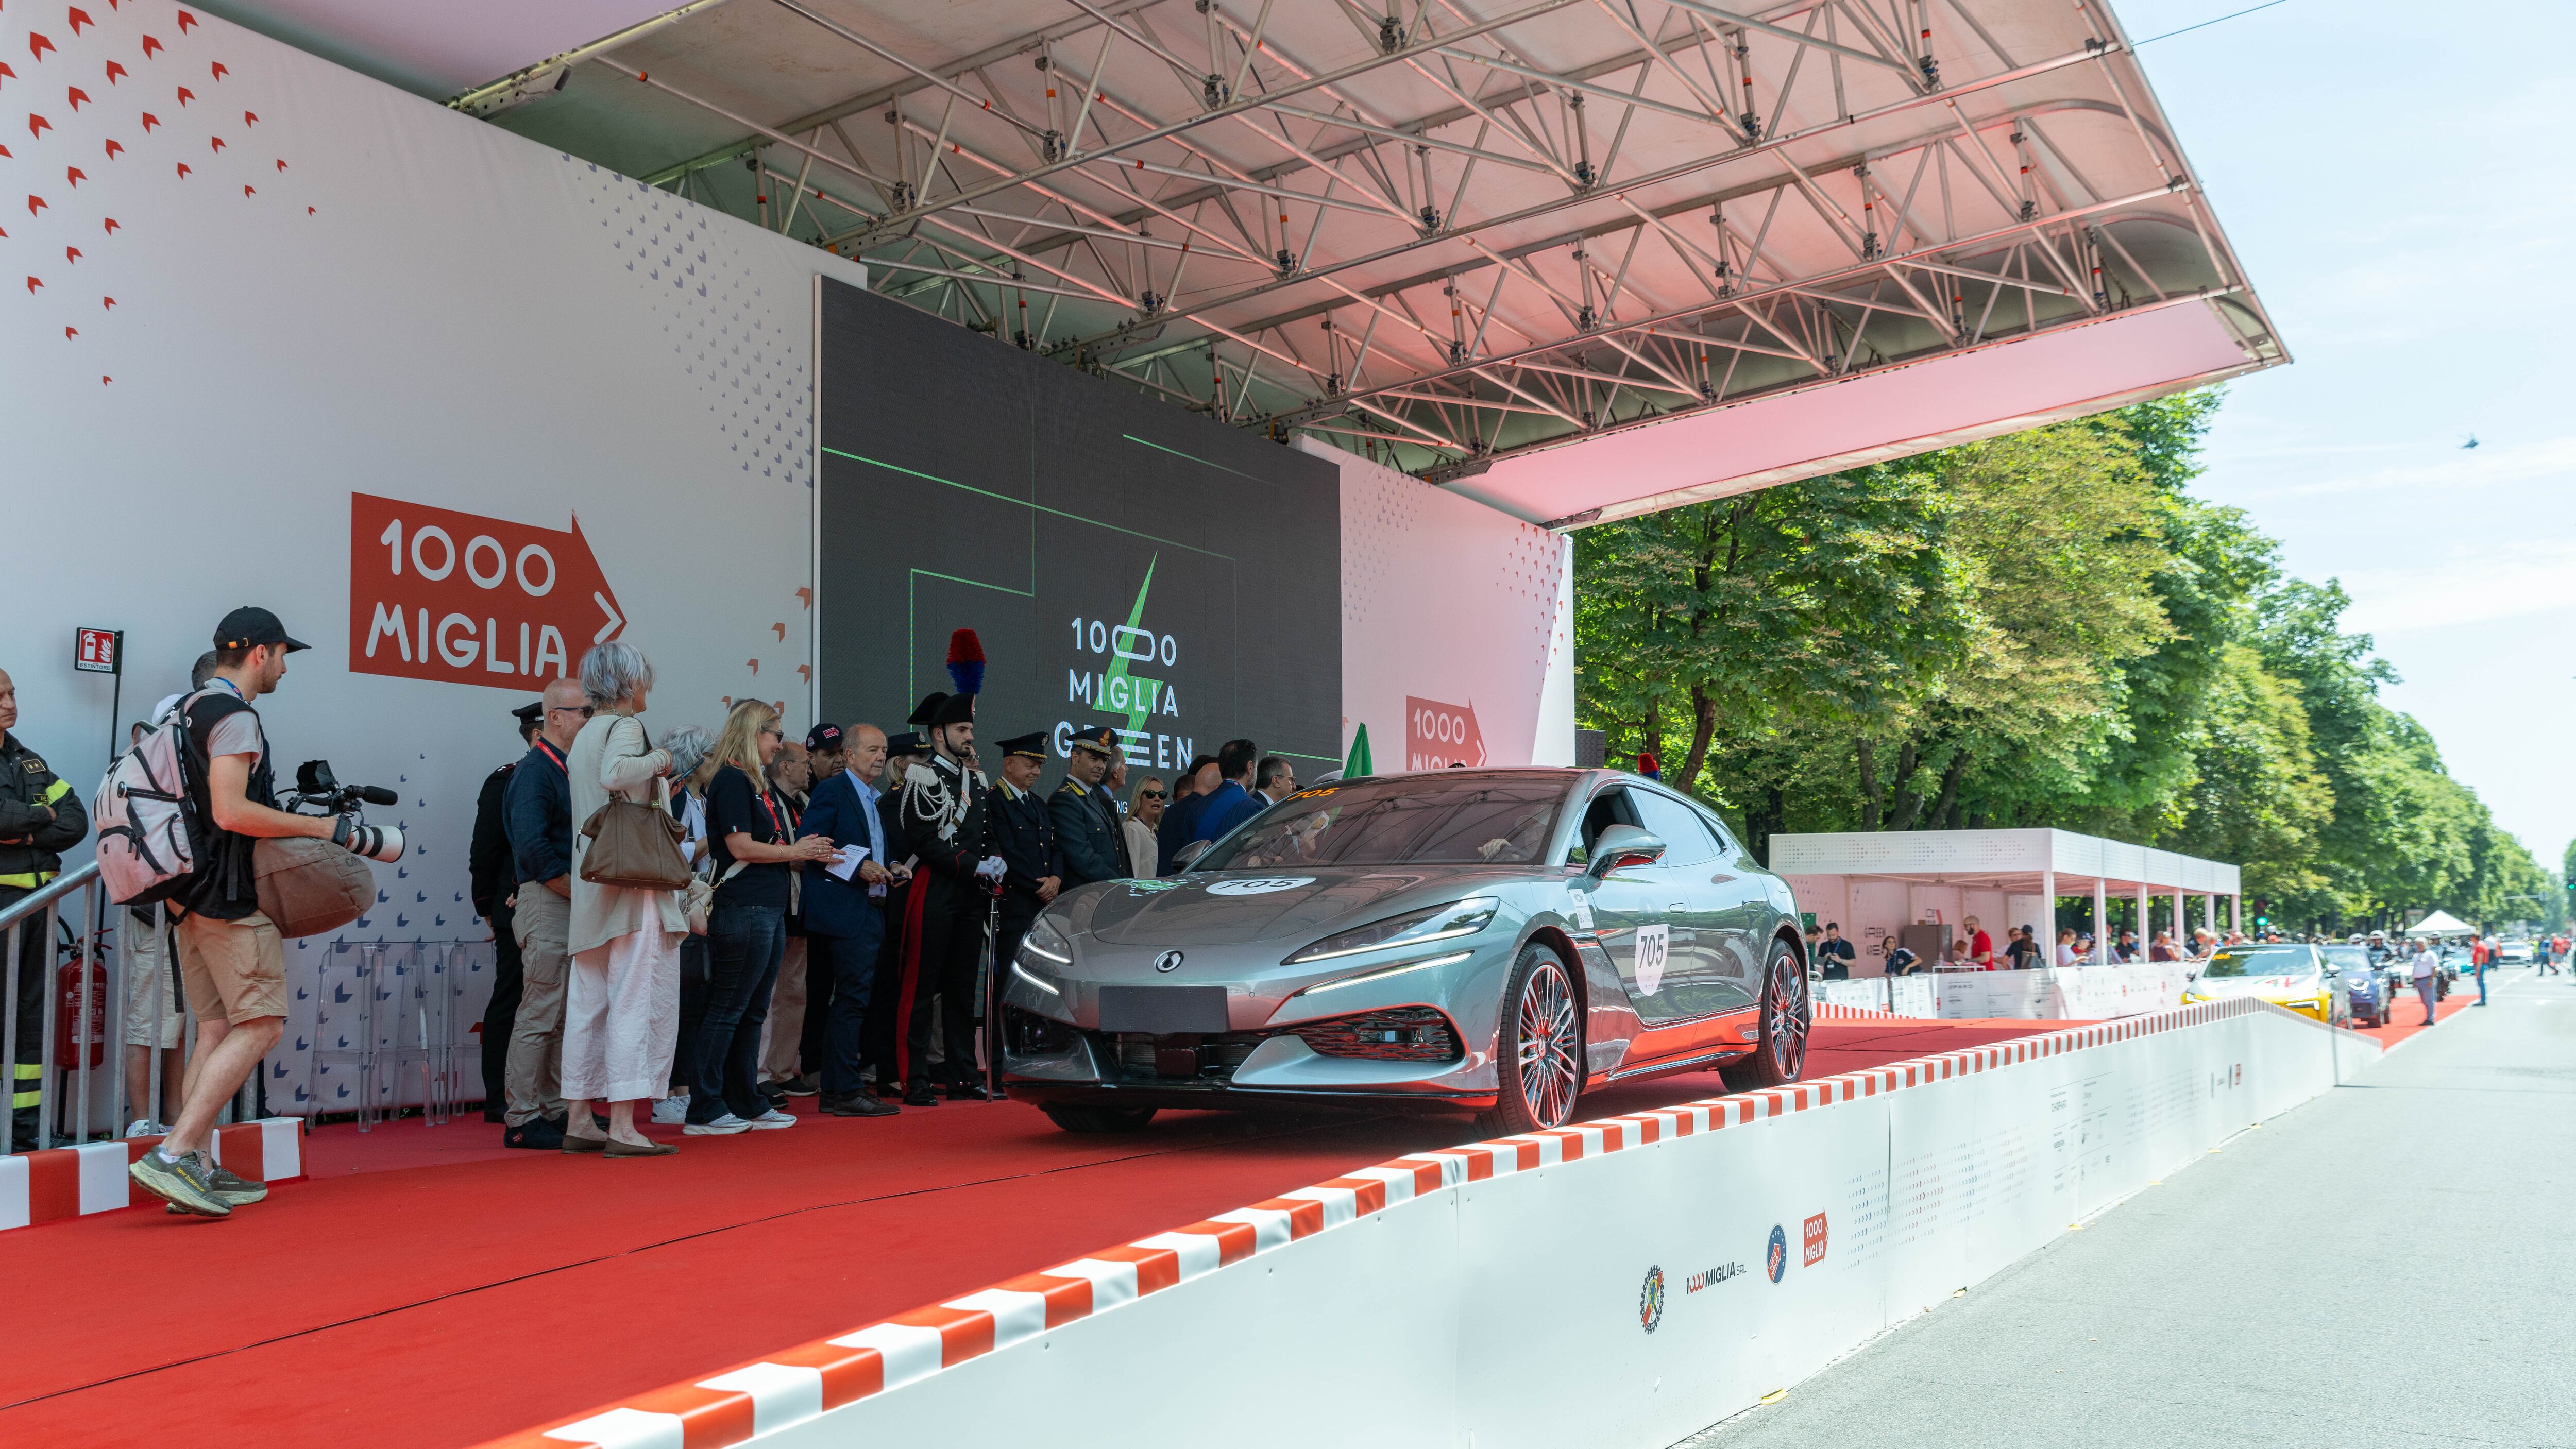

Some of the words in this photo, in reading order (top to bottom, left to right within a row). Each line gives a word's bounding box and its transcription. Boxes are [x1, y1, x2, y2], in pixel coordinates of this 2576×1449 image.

[381, 518, 556, 597] 1000
[365, 601, 567, 679] MIGLIA
[1072, 617, 1177, 667] 1000
[1069, 669, 1179, 717] MIGLIA
[1414, 707, 1465, 745] 1000
[1054, 721, 1193, 770] GEEN
[1287, 787, 1340, 801] 705
[1218, 880, 1299, 889] 705
[1639, 934, 1664, 968] 705
[176, 1167, 187, 1177] new
[185, 1175, 205, 1192] balance
[1806, 1218, 1823, 1239] 1000
[1805, 1240, 1824, 1264] MIGLIA
[1736, 1263, 1747, 1276] SRL
